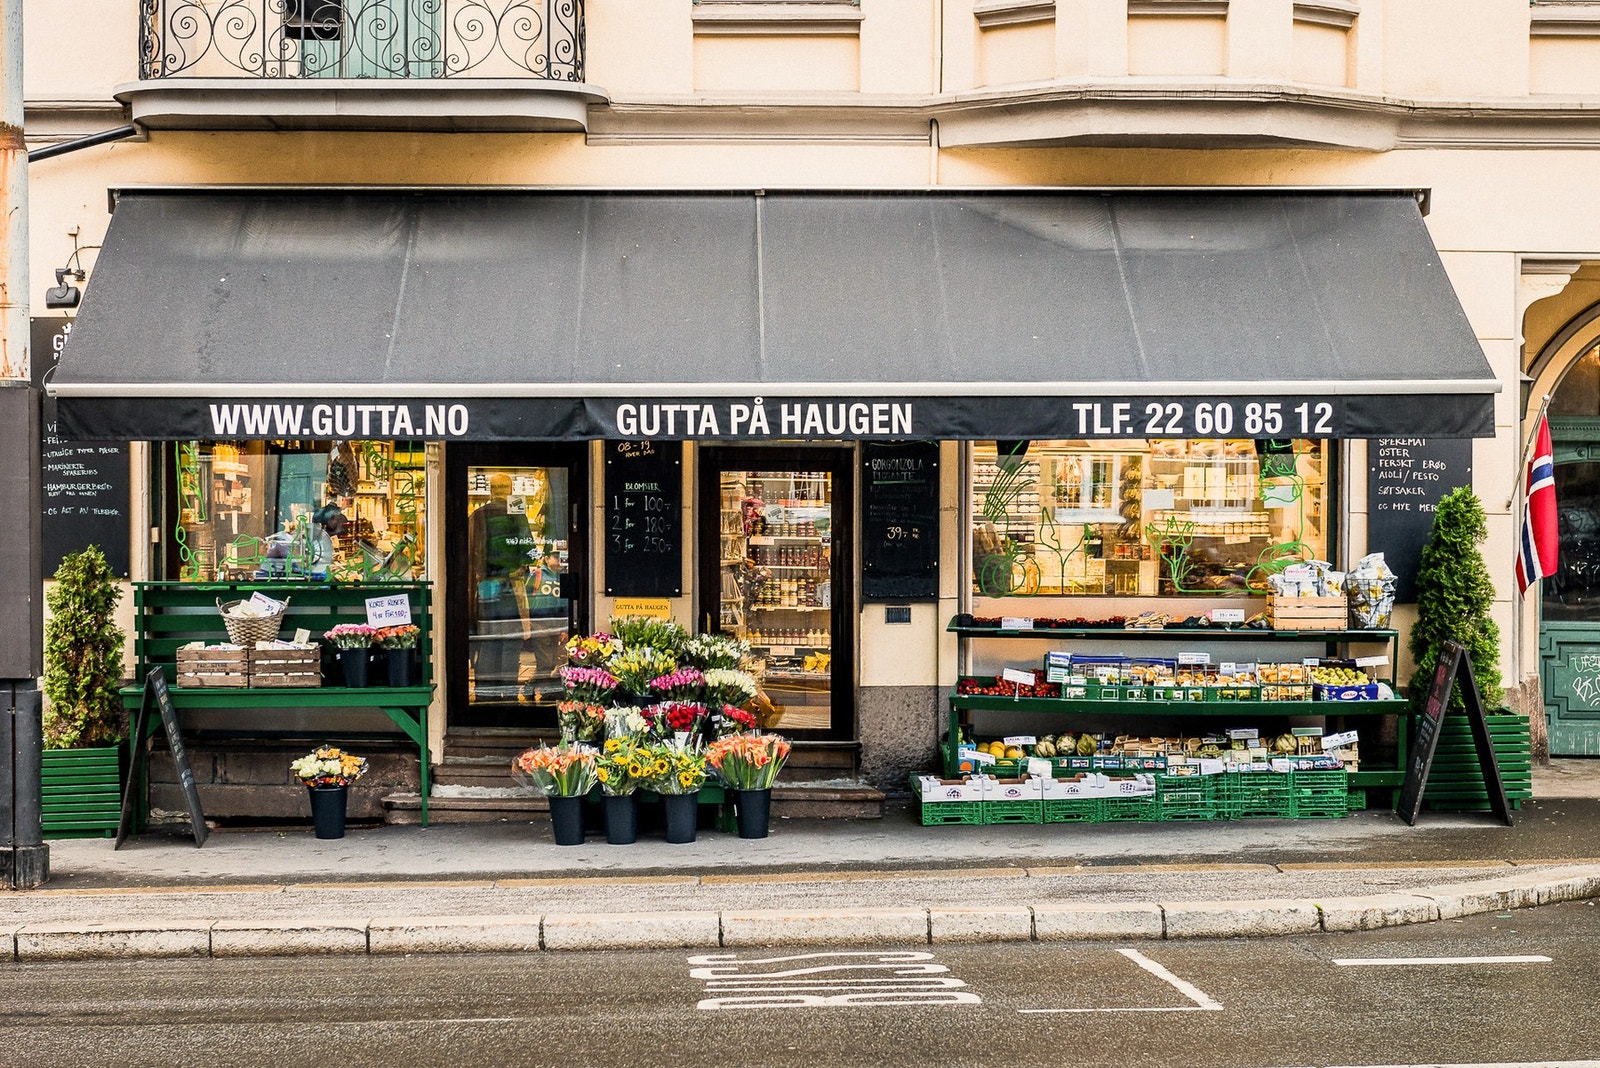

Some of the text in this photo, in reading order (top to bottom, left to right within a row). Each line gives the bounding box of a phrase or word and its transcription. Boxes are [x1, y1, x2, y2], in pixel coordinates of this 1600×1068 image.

[209, 404, 469, 436] WWW.GUTTA.NO
[616, 397, 912, 436] GUTTA PÅ HAUGEN
[1072, 402, 1333, 434] TLF. 22 60 85 12
[1379, 448, 1410, 457] OSTER
[871, 458, 925, 471] GORGONZOLA
[1379, 459, 1446, 471] FERSKT BRØD
[1412, 471, 1440, 481] PESTO
[625, 482, 661, 492] BLOMSTER
[1378, 486, 1426, 496] SØTSAKER
[1392, 503, 1411, 511] MYE
